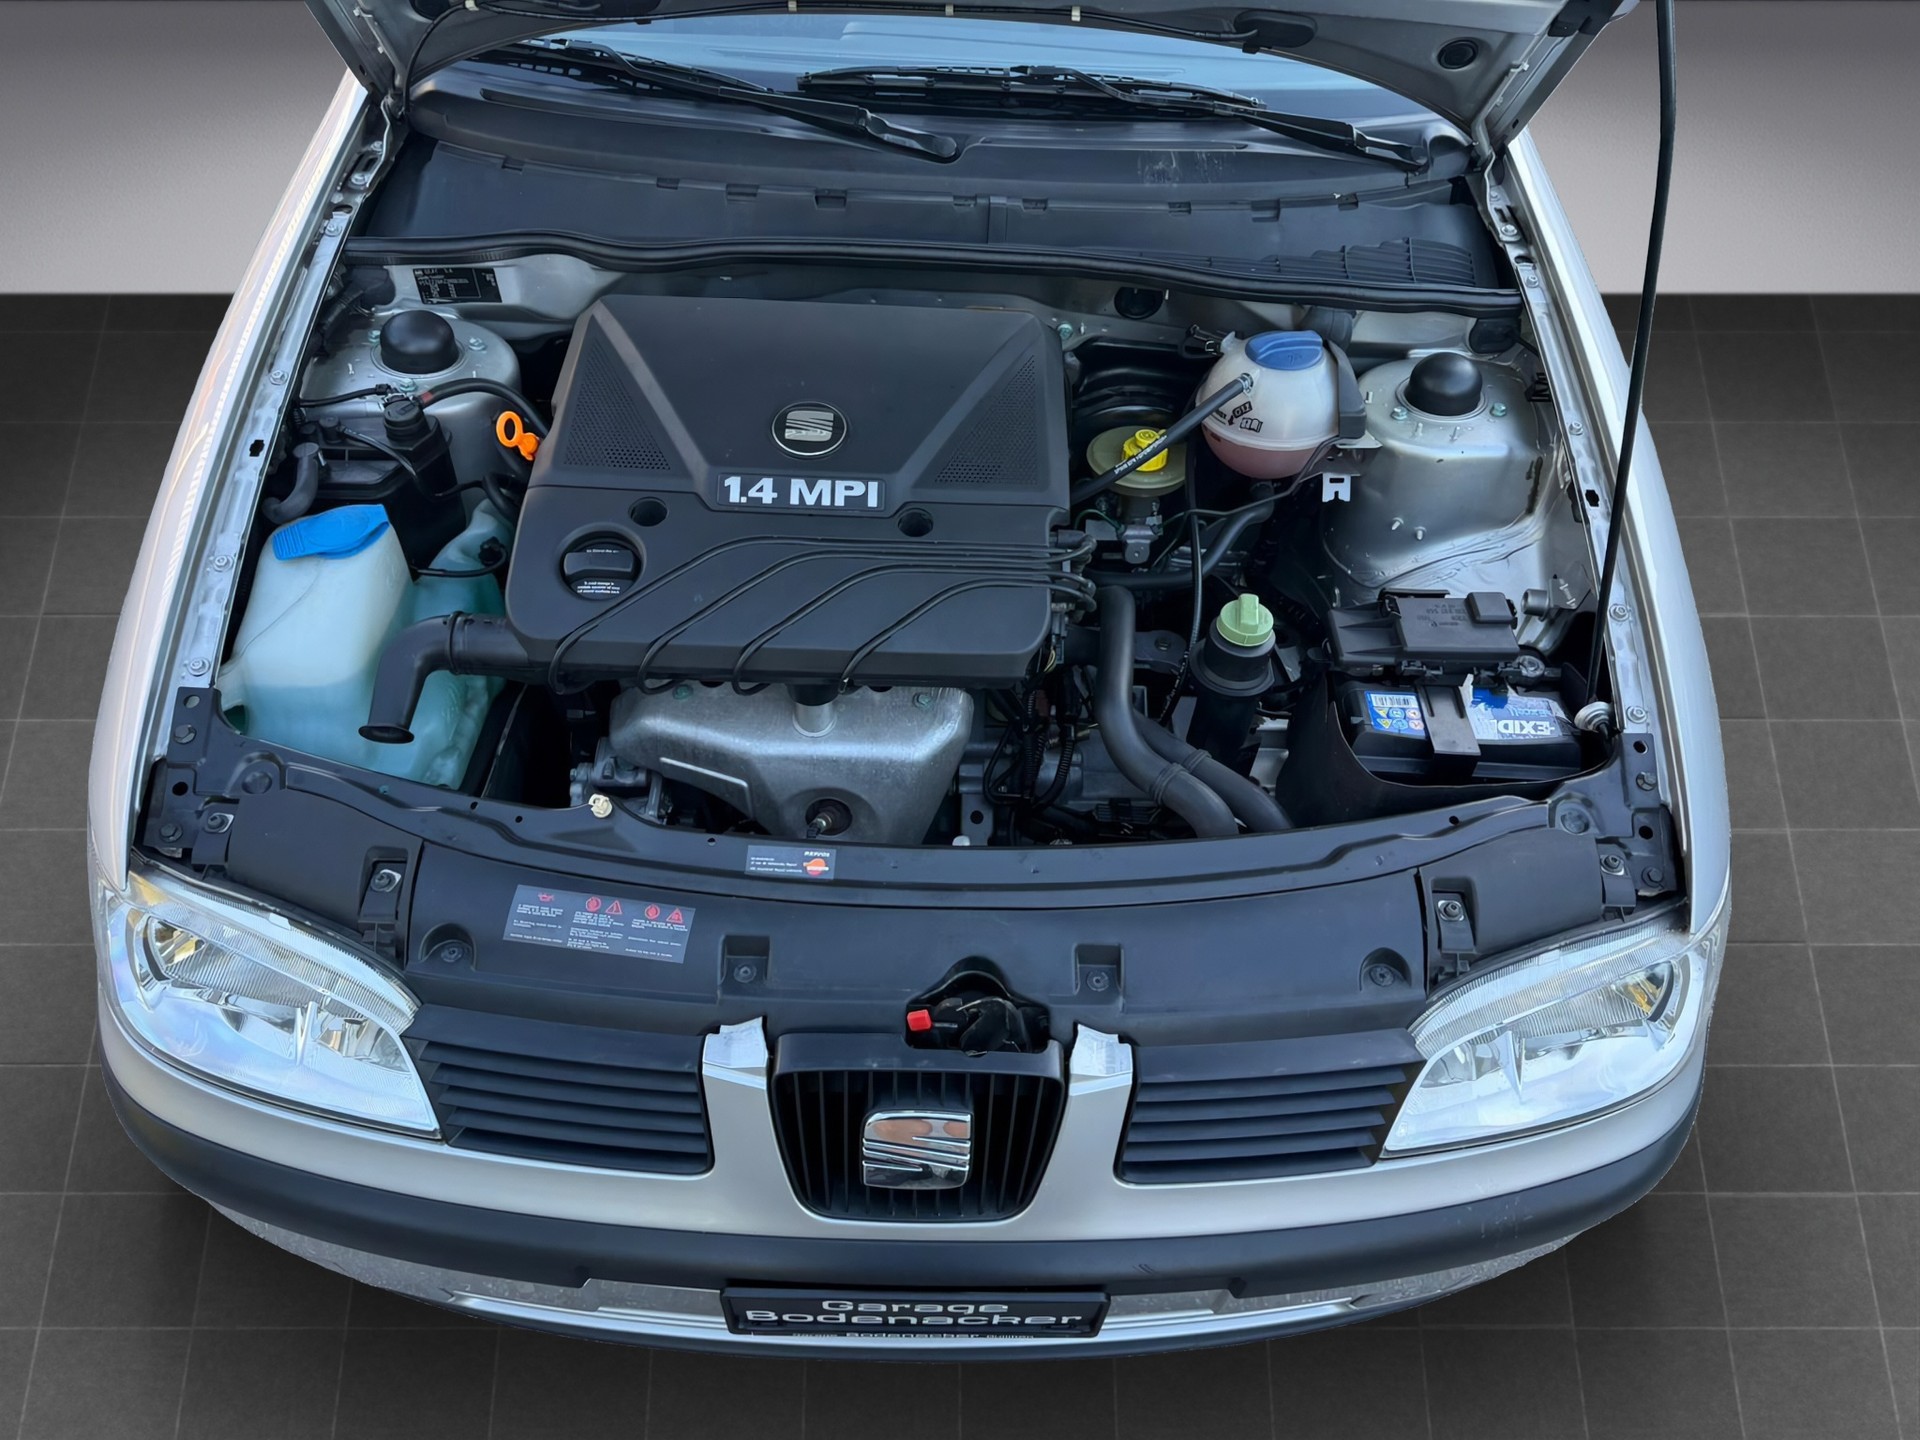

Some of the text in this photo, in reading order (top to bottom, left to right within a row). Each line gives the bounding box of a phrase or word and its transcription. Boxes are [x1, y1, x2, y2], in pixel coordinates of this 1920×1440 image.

[724, 476, 878, 508] 1.4 MPI
[822, 1300, 1009, 1314] Garage
